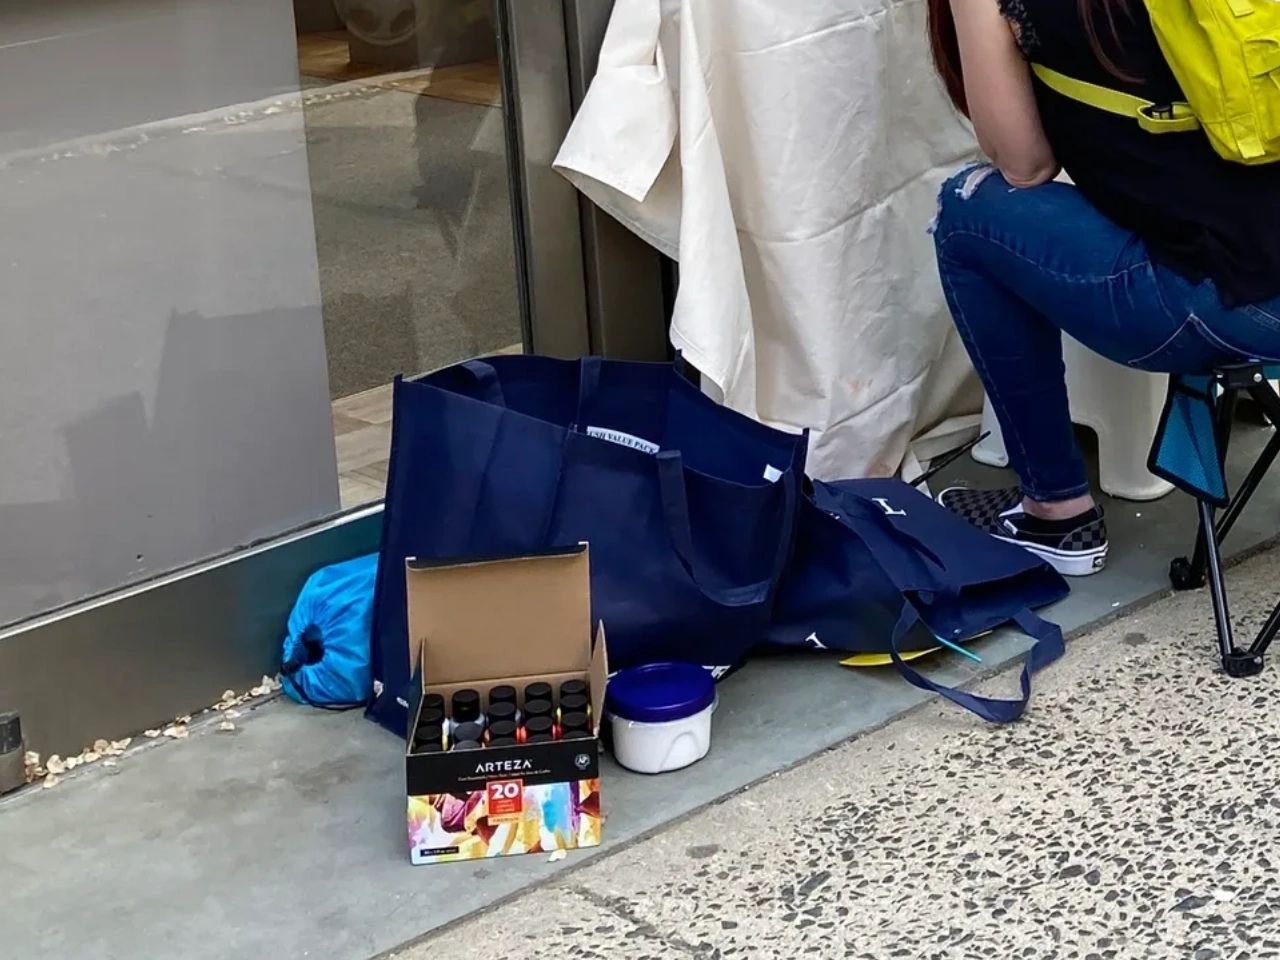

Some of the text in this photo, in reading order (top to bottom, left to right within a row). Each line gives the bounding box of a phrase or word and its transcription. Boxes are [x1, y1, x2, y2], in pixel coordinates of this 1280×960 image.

[607, 432, 633, 446] VALUE
[475, 759, 532, 774] ARTEZA
[491, 783, 519, 800] 20
